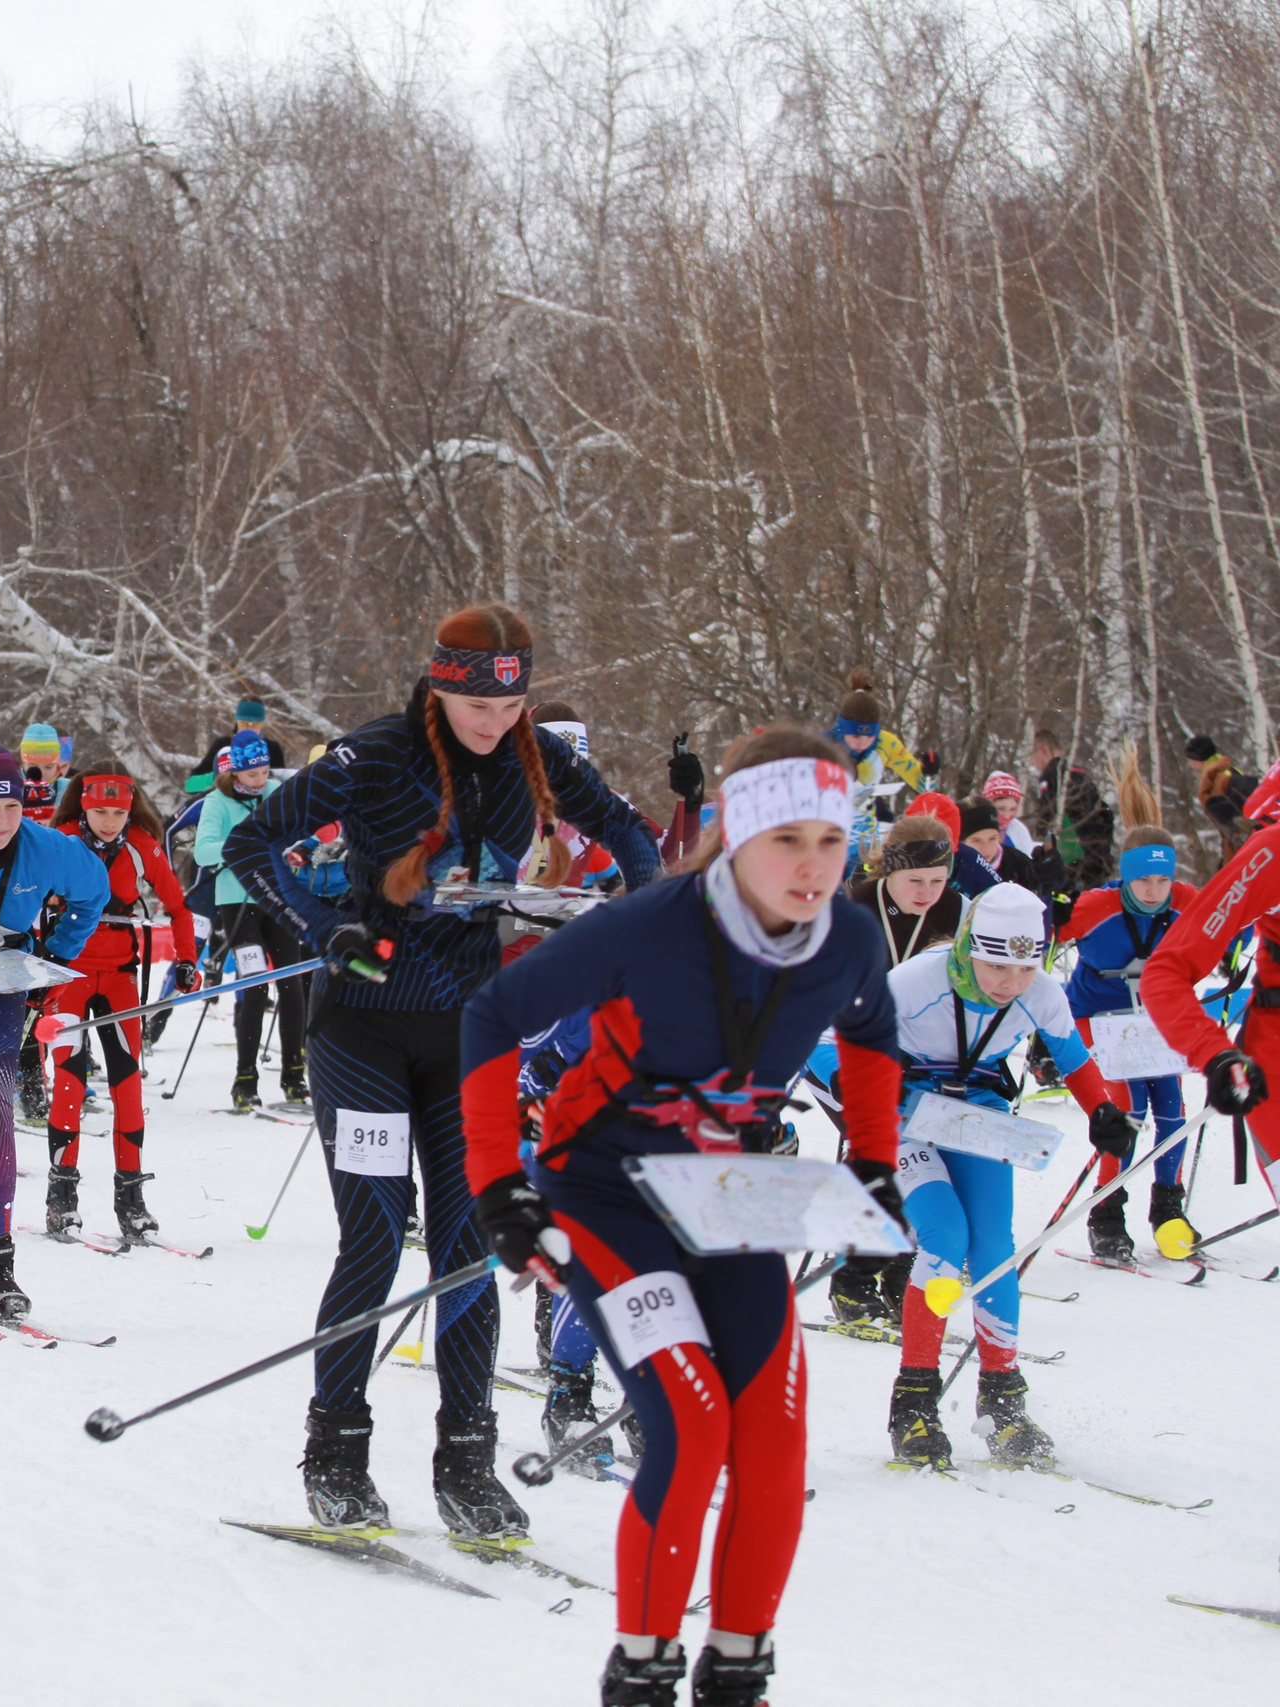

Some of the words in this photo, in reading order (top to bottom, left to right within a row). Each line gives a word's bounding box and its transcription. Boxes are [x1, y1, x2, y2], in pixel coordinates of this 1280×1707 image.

[1202, 847, 1273, 939] BRIKO
[242, 952, 257, 962] 954
[354, 1127, 388, 1147] 918
[899, 1150, 930, 1170] 916
[626, 1286, 676, 1318] 909
[449, 1433, 485, 1442] salomon
